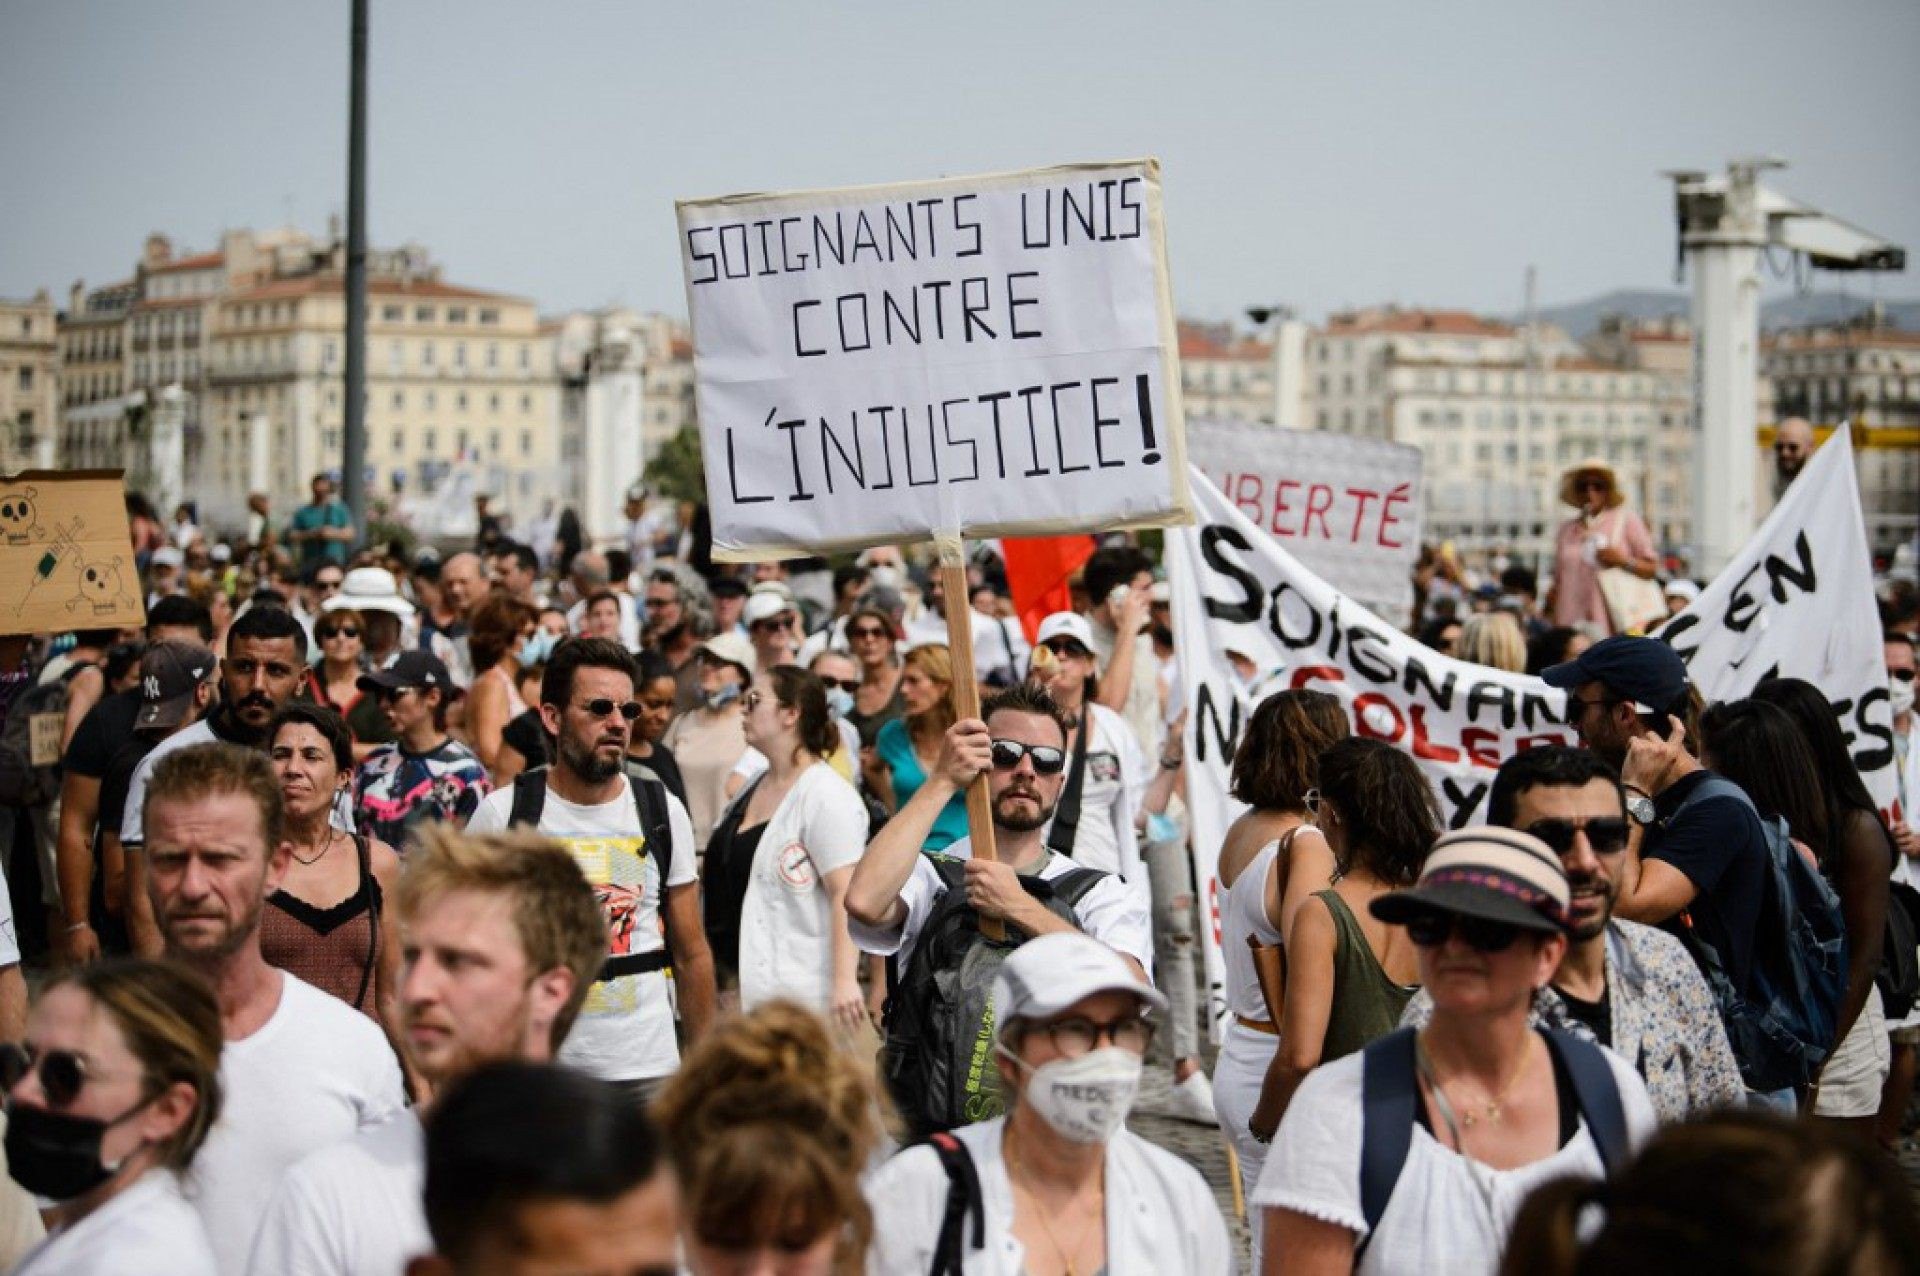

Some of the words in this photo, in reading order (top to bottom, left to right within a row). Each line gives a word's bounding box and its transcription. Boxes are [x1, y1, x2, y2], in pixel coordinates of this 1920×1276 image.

[687, 194, 983, 284] SOIGNANTS
[1021, 177, 1142, 248] UNIS
[792, 271, 1043, 357] CONTRE
[726, 374, 1162, 504] L'INJUSTICE!
[1201, 470, 1411, 547] IBERTÉ
